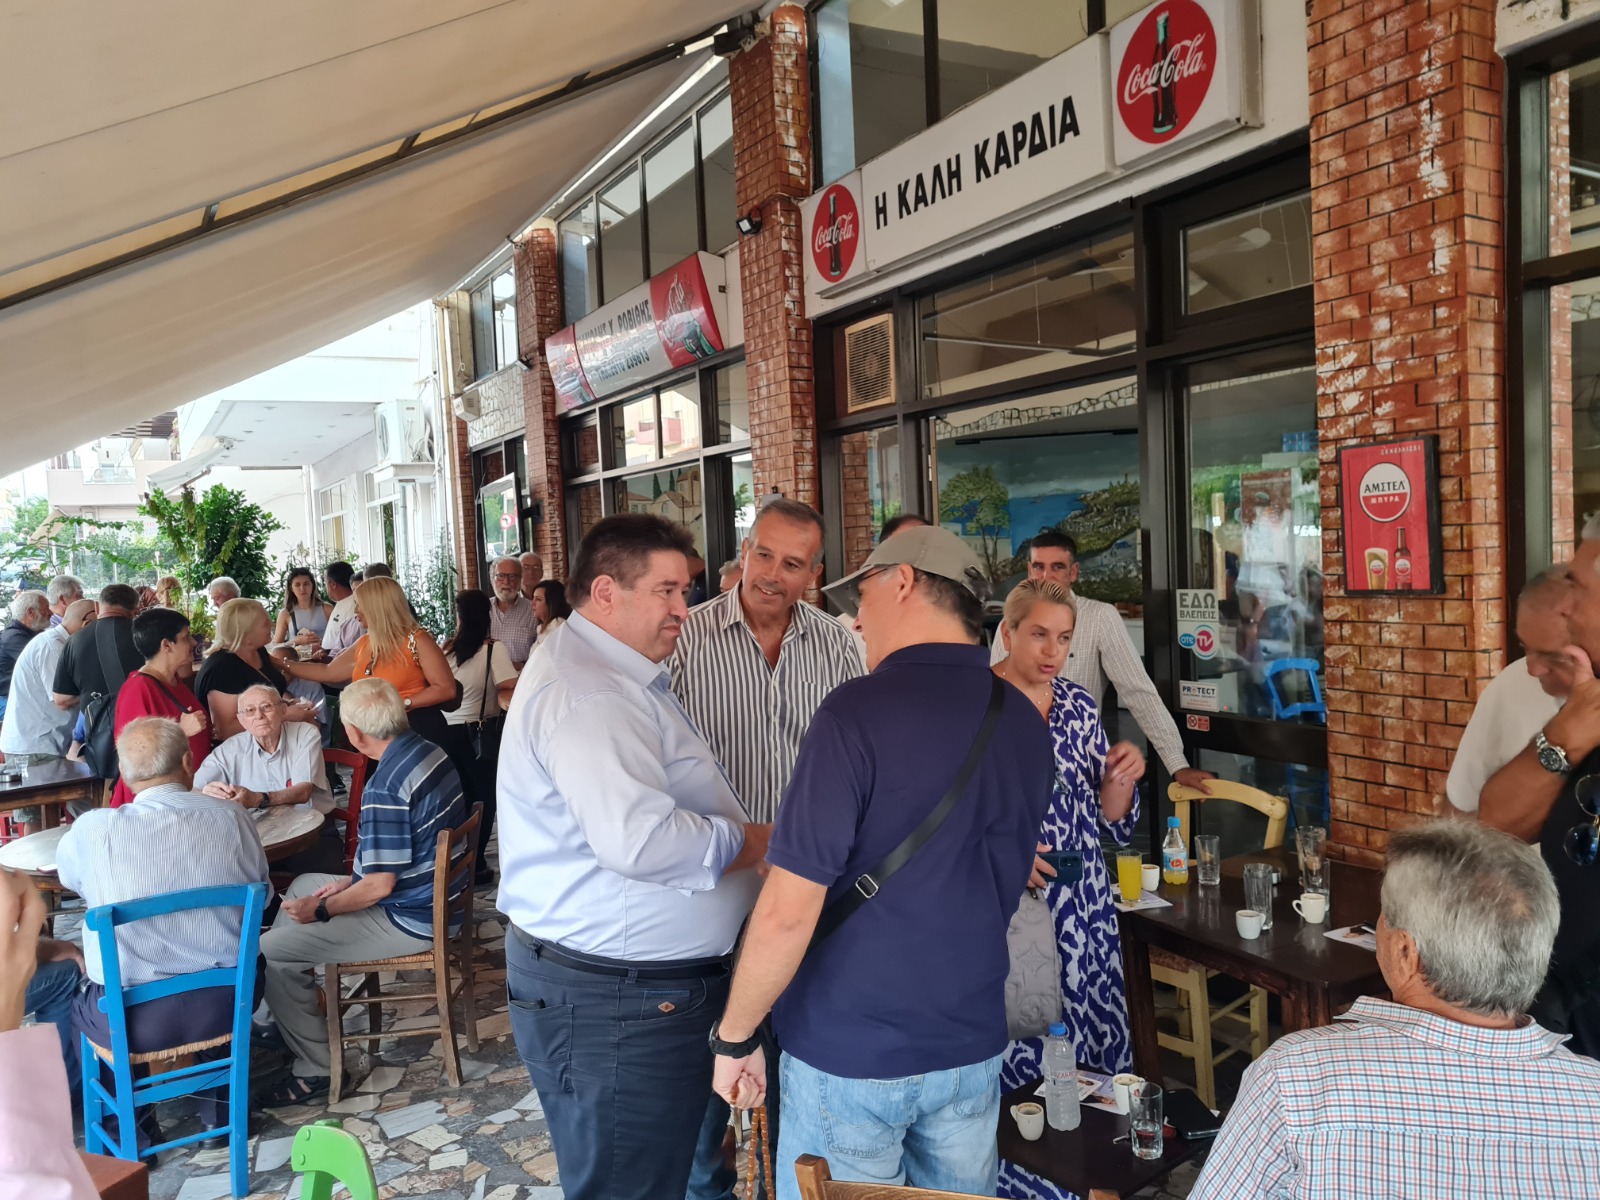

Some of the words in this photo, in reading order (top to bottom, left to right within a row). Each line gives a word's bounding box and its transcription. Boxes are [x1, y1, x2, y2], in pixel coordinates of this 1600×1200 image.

[1124, 32, 1206, 105] Coca-Cola
[874, 191, 888, 230] Η
[897, 153, 962, 219] ΚΑΛΗ
[974, 96, 1080, 184] ΚΑΡΔΙΑ
[815, 211, 854, 253] Coca-Cola
[617, 299, 652, 333] ΡΟΒΙΘΗΣ
[1364, 480, 1405, 494] ΑΜΣΤΕΛ
[1370, 496, 1400, 505] ΜΠΥΡΑ
[1179, 592, 1216, 609] ΕΔΩ
[1179, 610, 1217, 620] ΒΛΕΠΕΙΣ
[1196, 634, 1213, 647] TV
